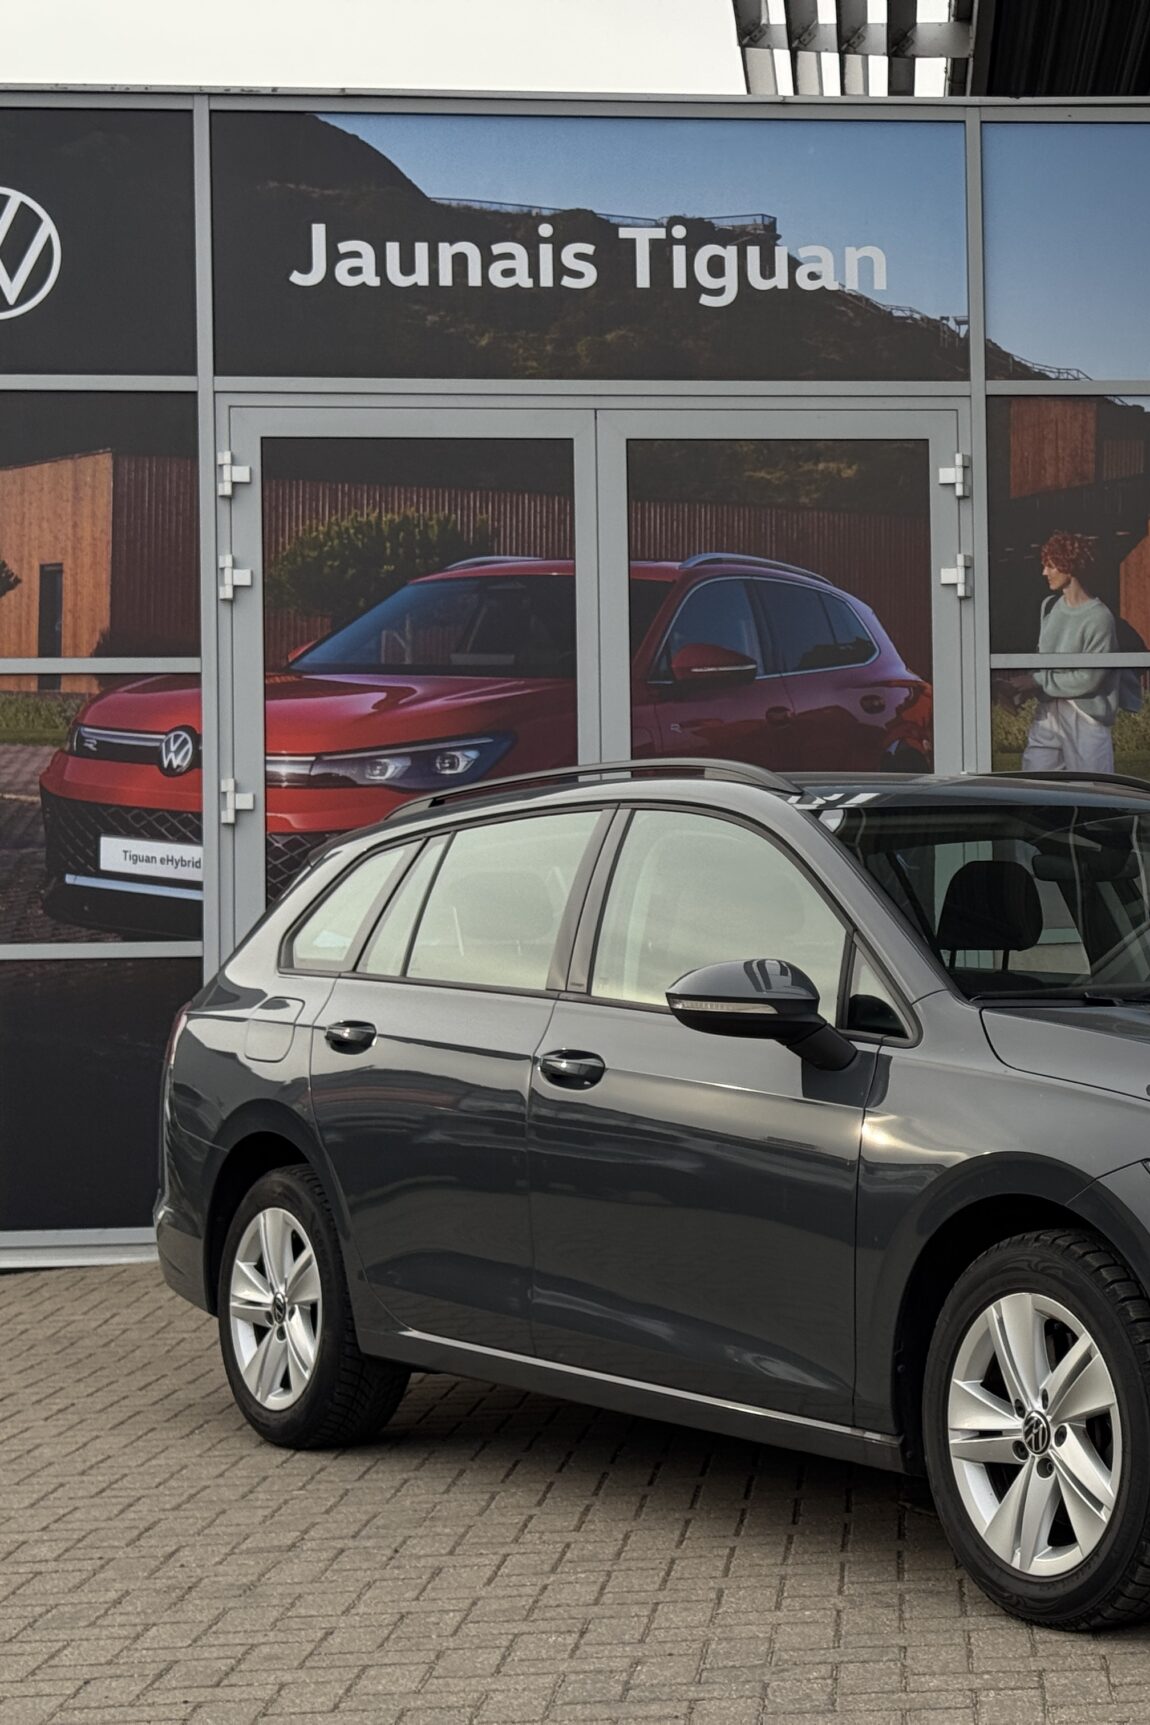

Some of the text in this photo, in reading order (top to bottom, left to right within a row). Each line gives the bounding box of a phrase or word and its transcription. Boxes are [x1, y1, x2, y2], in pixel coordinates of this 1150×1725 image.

[288, 223, 888, 308] Jaunais Tiguan
[122, 849, 202, 870] Tiguan eHybrid
